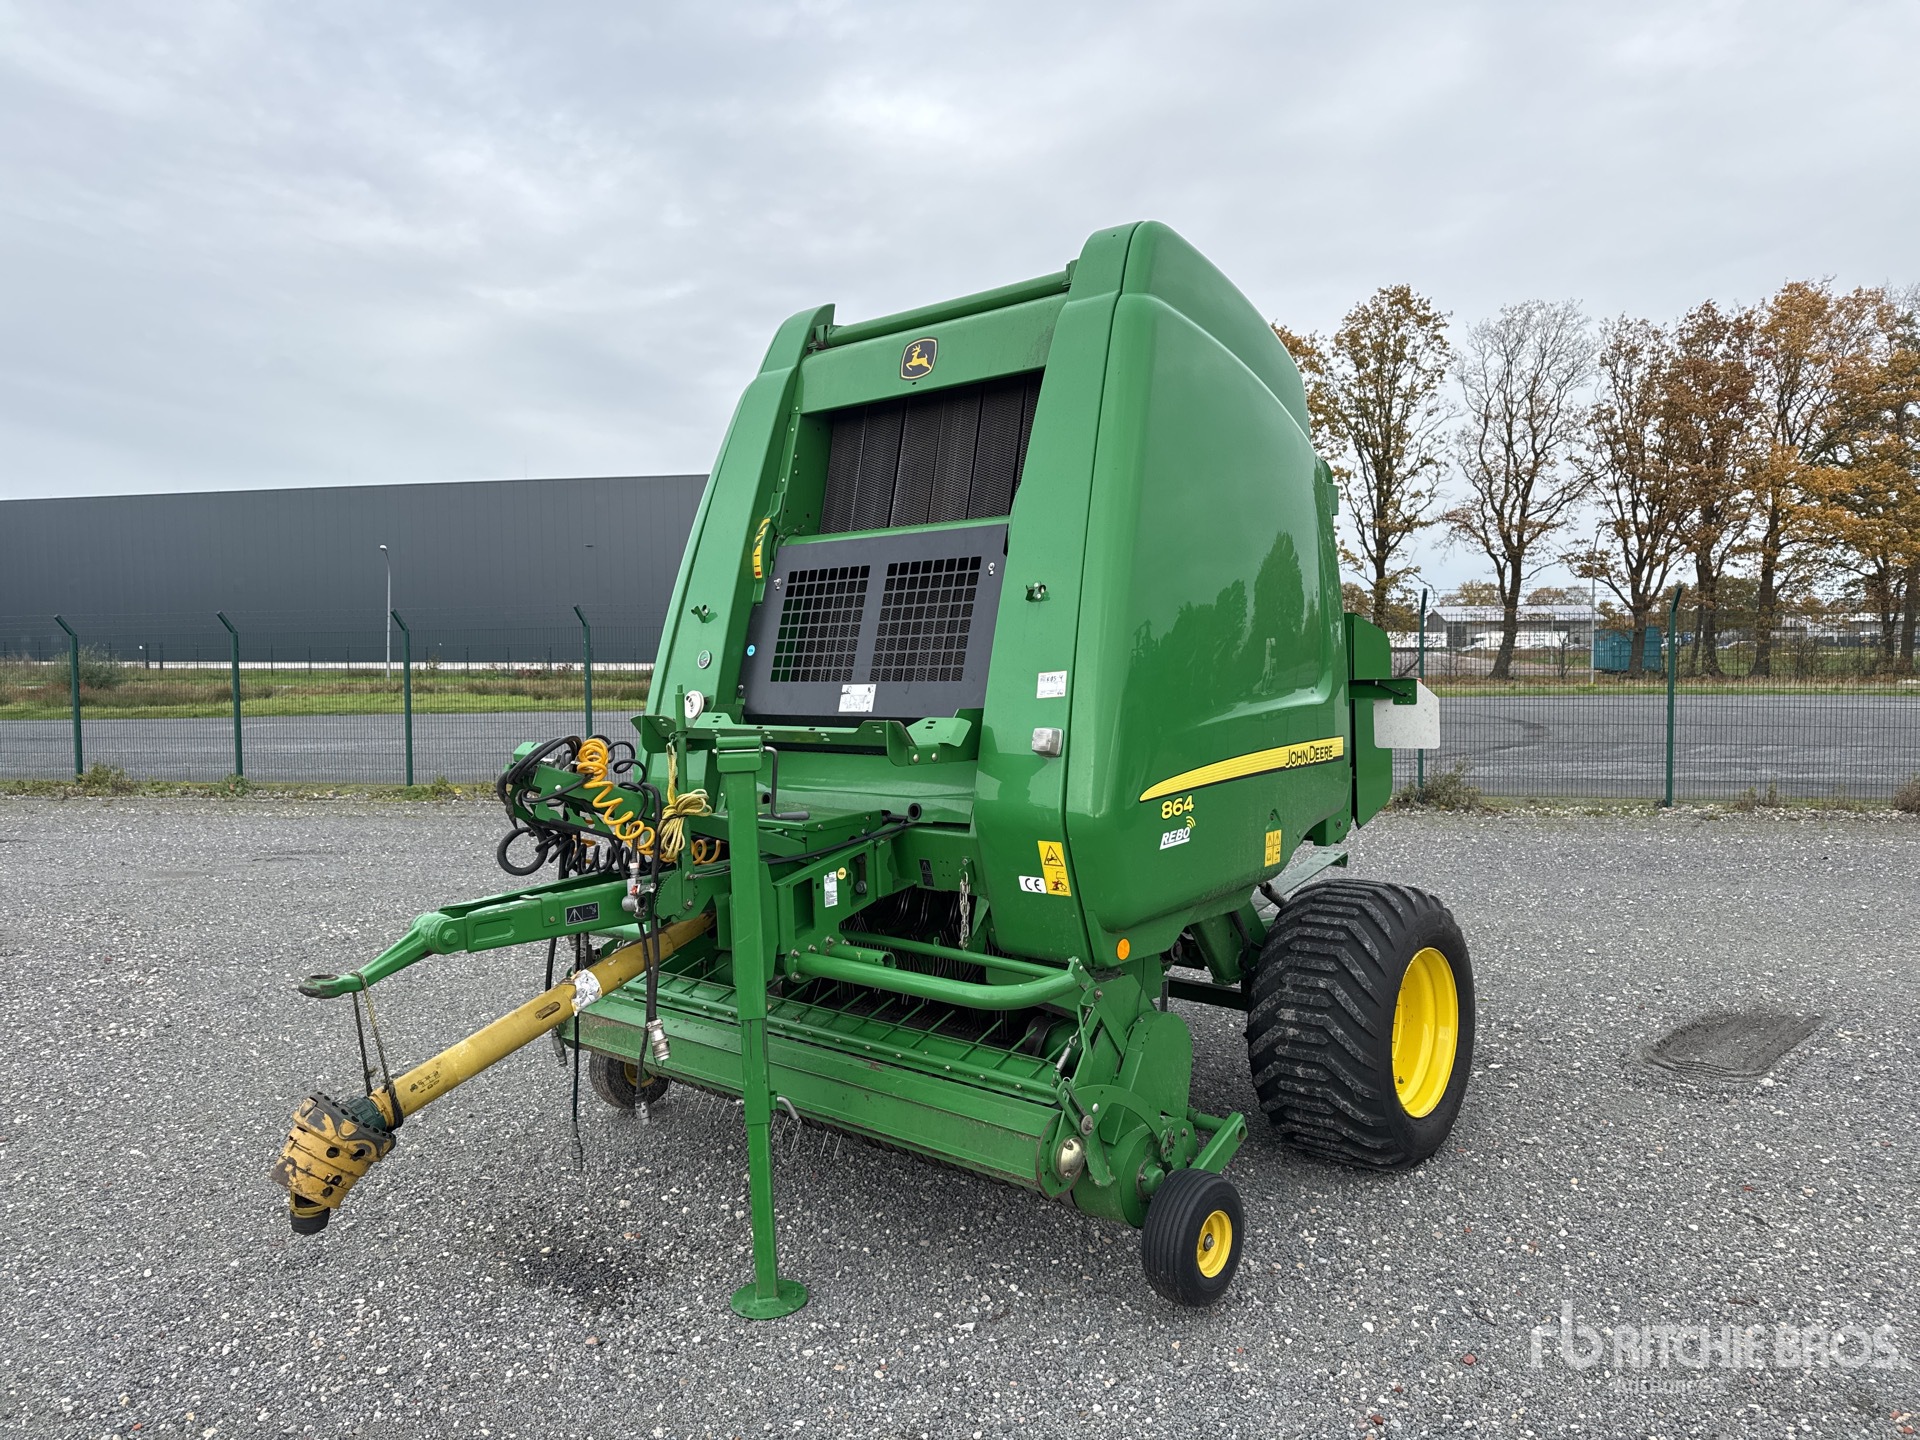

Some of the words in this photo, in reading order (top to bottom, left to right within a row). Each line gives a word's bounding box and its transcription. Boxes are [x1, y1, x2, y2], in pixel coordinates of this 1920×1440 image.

[1286, 749, 1309, 766] JOHN
[1309, 745, 1333, 762] DEERE
[1161, 794, 1195, 820] 864
[1161, 826, 1191, 846] REBO
